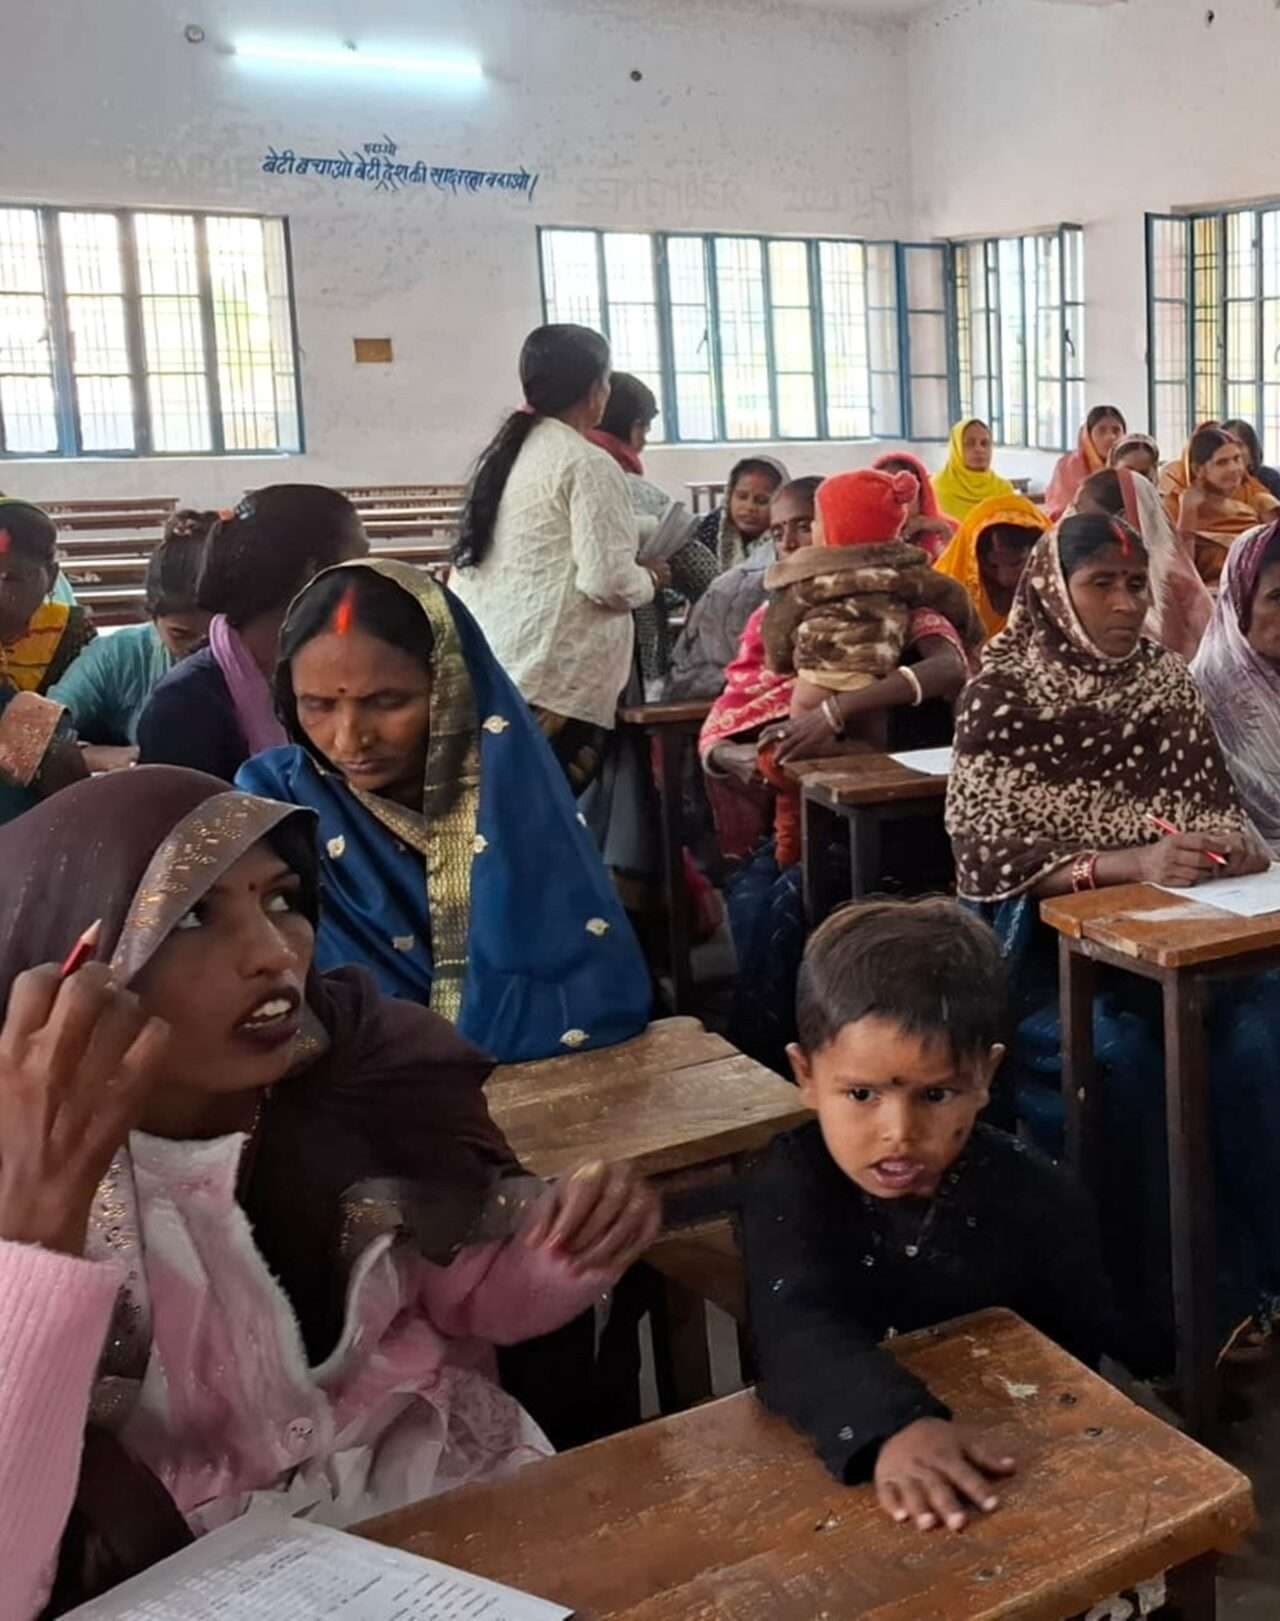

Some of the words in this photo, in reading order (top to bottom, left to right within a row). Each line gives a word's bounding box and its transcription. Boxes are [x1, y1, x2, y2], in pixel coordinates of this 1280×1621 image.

[263, 146, 295, 175] बेटी
[296, 150, 353, 179] बचाओ
[353, 151, 382, 182] बेटी
